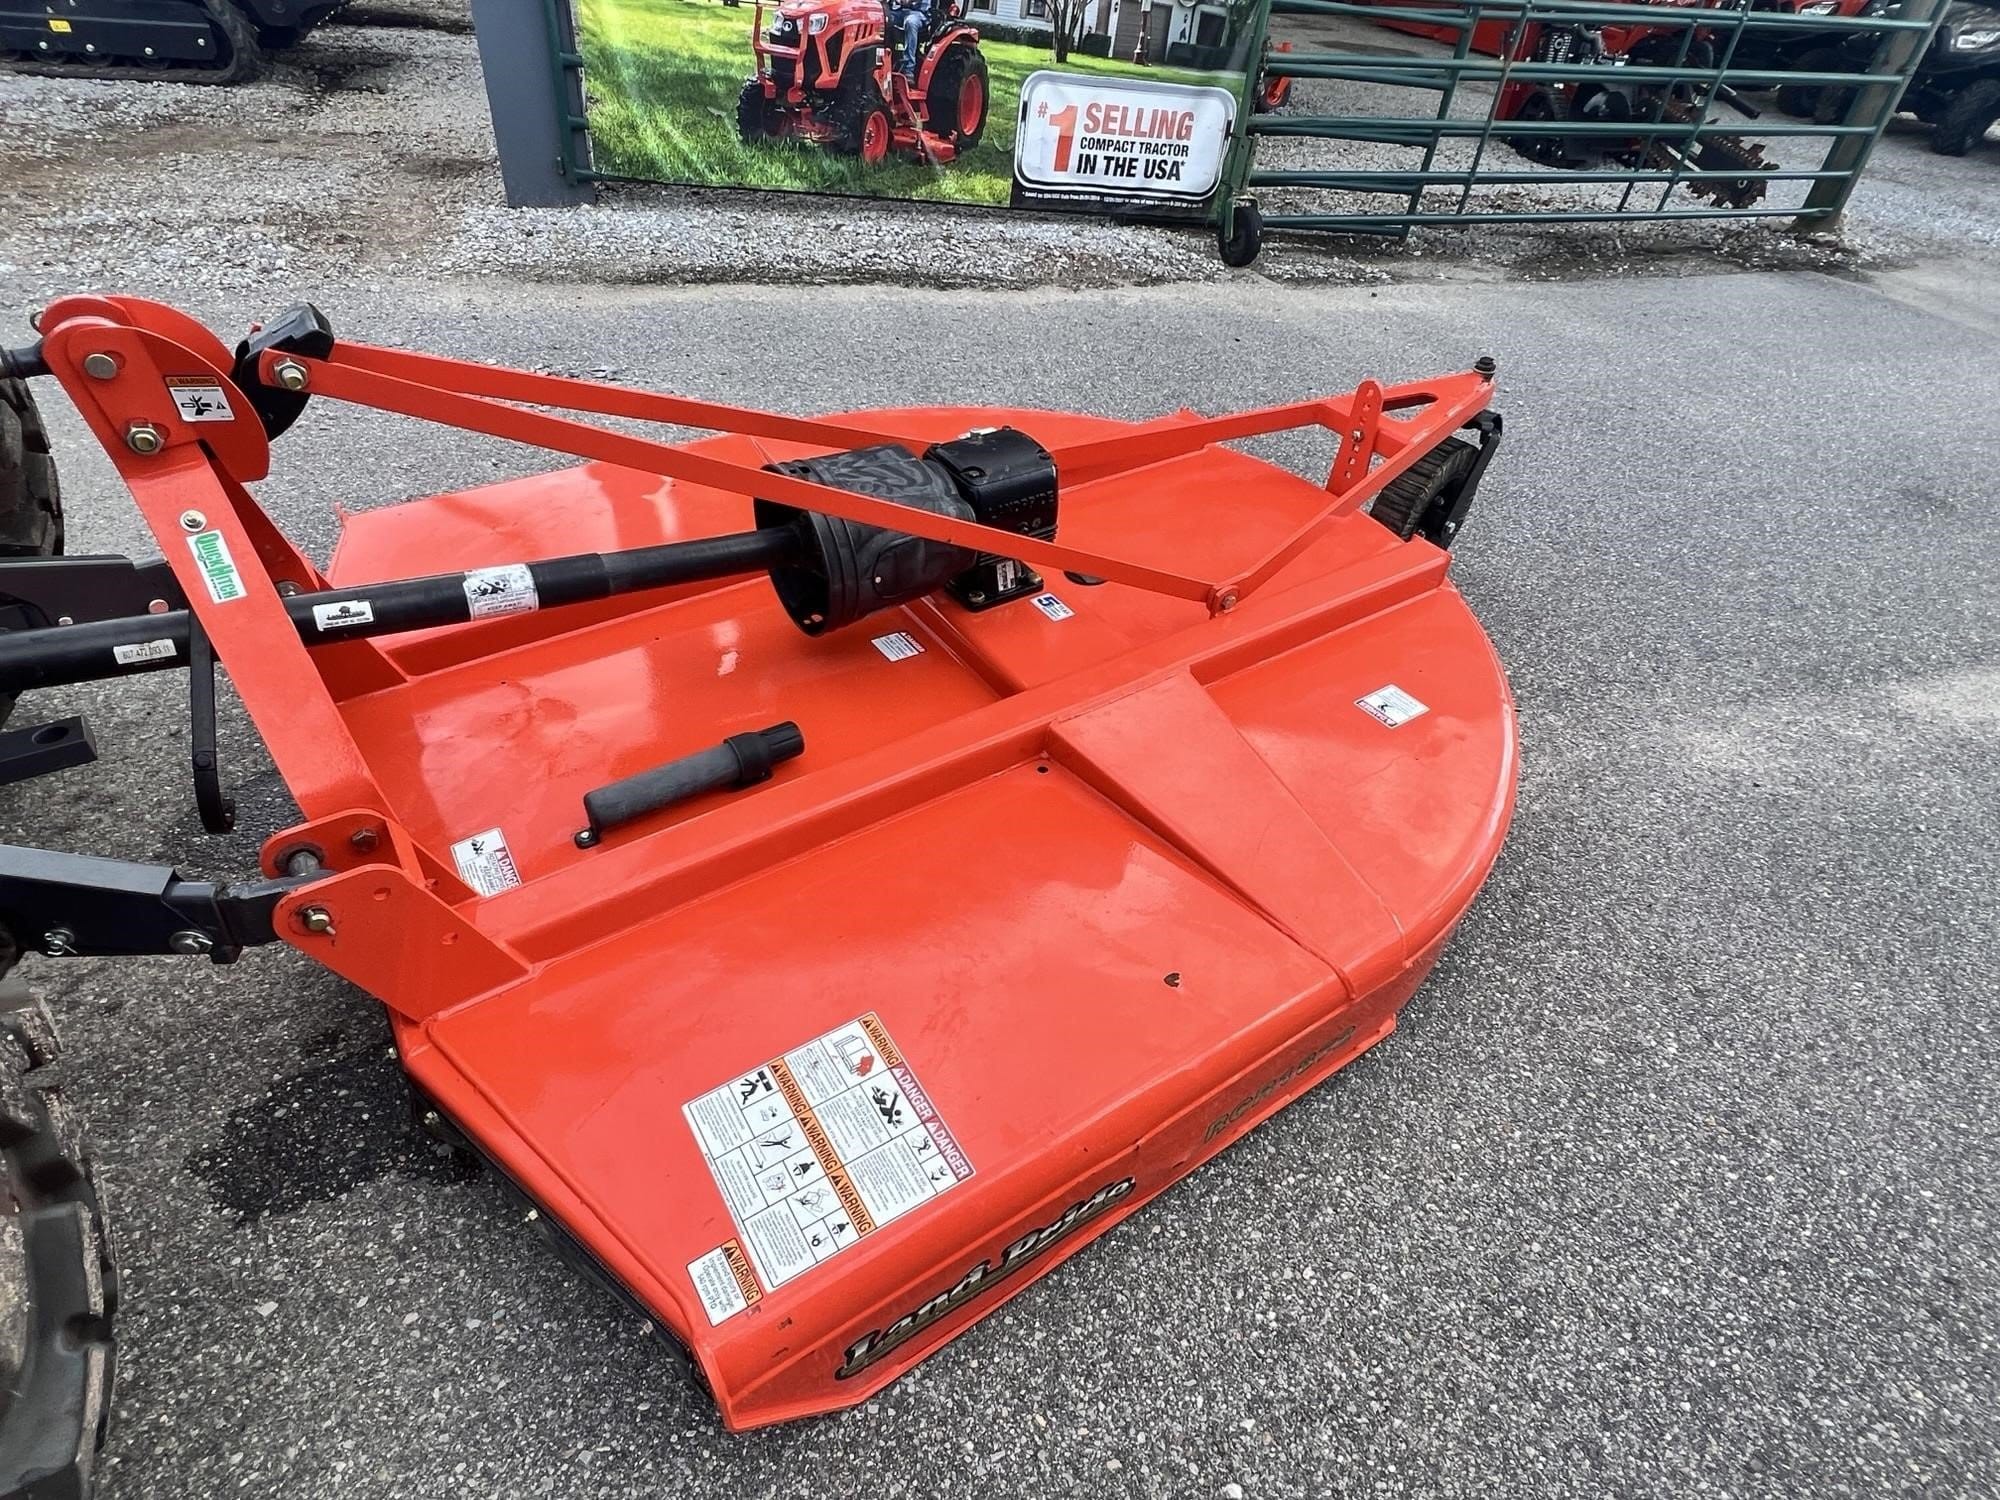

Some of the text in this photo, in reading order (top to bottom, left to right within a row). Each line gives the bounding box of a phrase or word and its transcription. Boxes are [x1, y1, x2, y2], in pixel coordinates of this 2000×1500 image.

[1083, 102, 1195, 141] SELLING
[1076, 153, 1098, 175] IN
[1103, 155, 1137, 177] THE
[1080, 136, 1189, 157] COMPACT TRACTOR
[1037, 596, 1060, 607] 5
[499, 858, 520, 889] DANGE
[867, 1025, 899, 1066] WARNING
[775, 1070, 807, 1113] WARNING
[896, 1074, 934, 1120] DANGER
[803, 1123, 839, 1170] WARNING
[931, 1128, 971, 1178] DANGER
[835, 1182, 872, 1233] WARNING
[729, 1253, 759, 1301] WARNING
